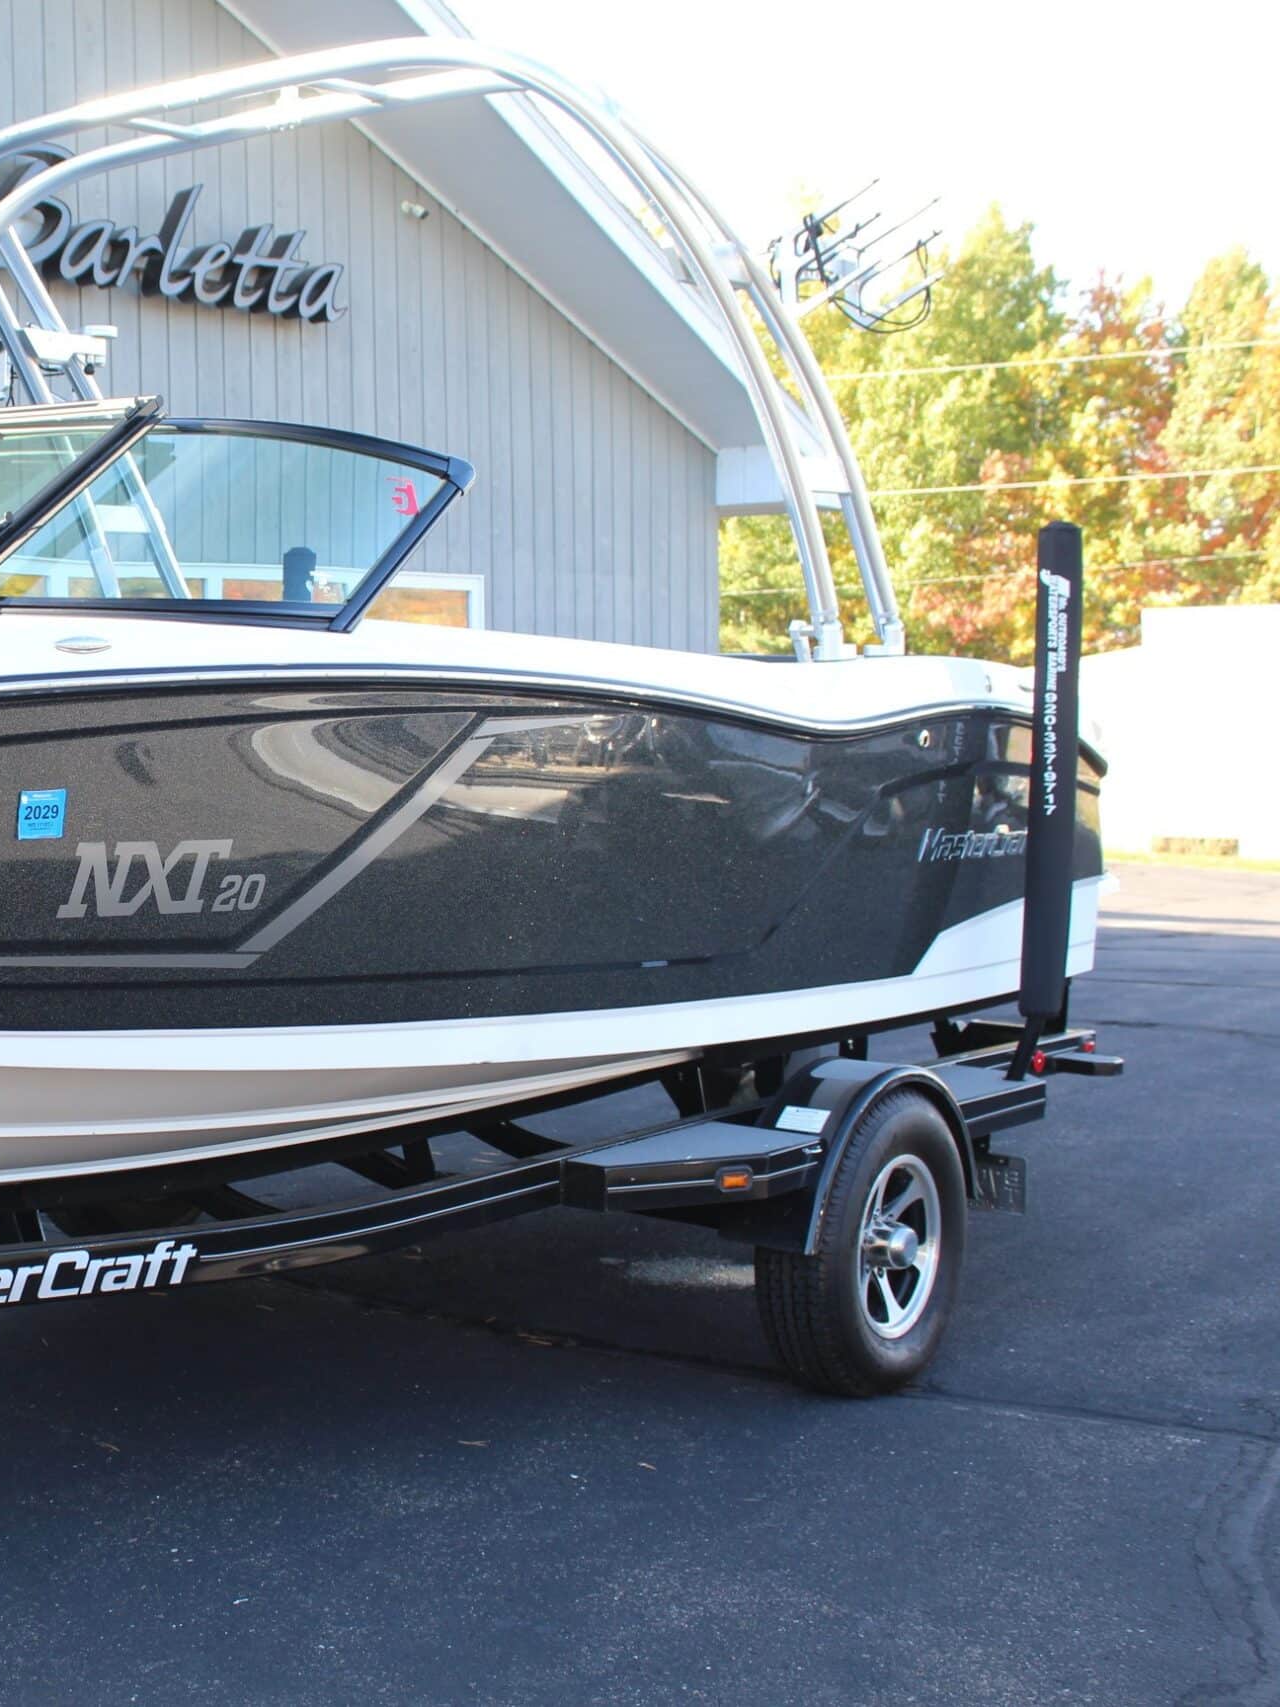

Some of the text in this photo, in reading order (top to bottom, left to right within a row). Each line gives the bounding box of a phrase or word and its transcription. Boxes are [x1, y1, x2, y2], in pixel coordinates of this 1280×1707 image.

[1046, 651, 1058, 691] MARINE
[24, 804, 60, 821] 2029
[918, 826, 1028, 862] MasterCra
[56, 839, 267, 919] NXT 20
